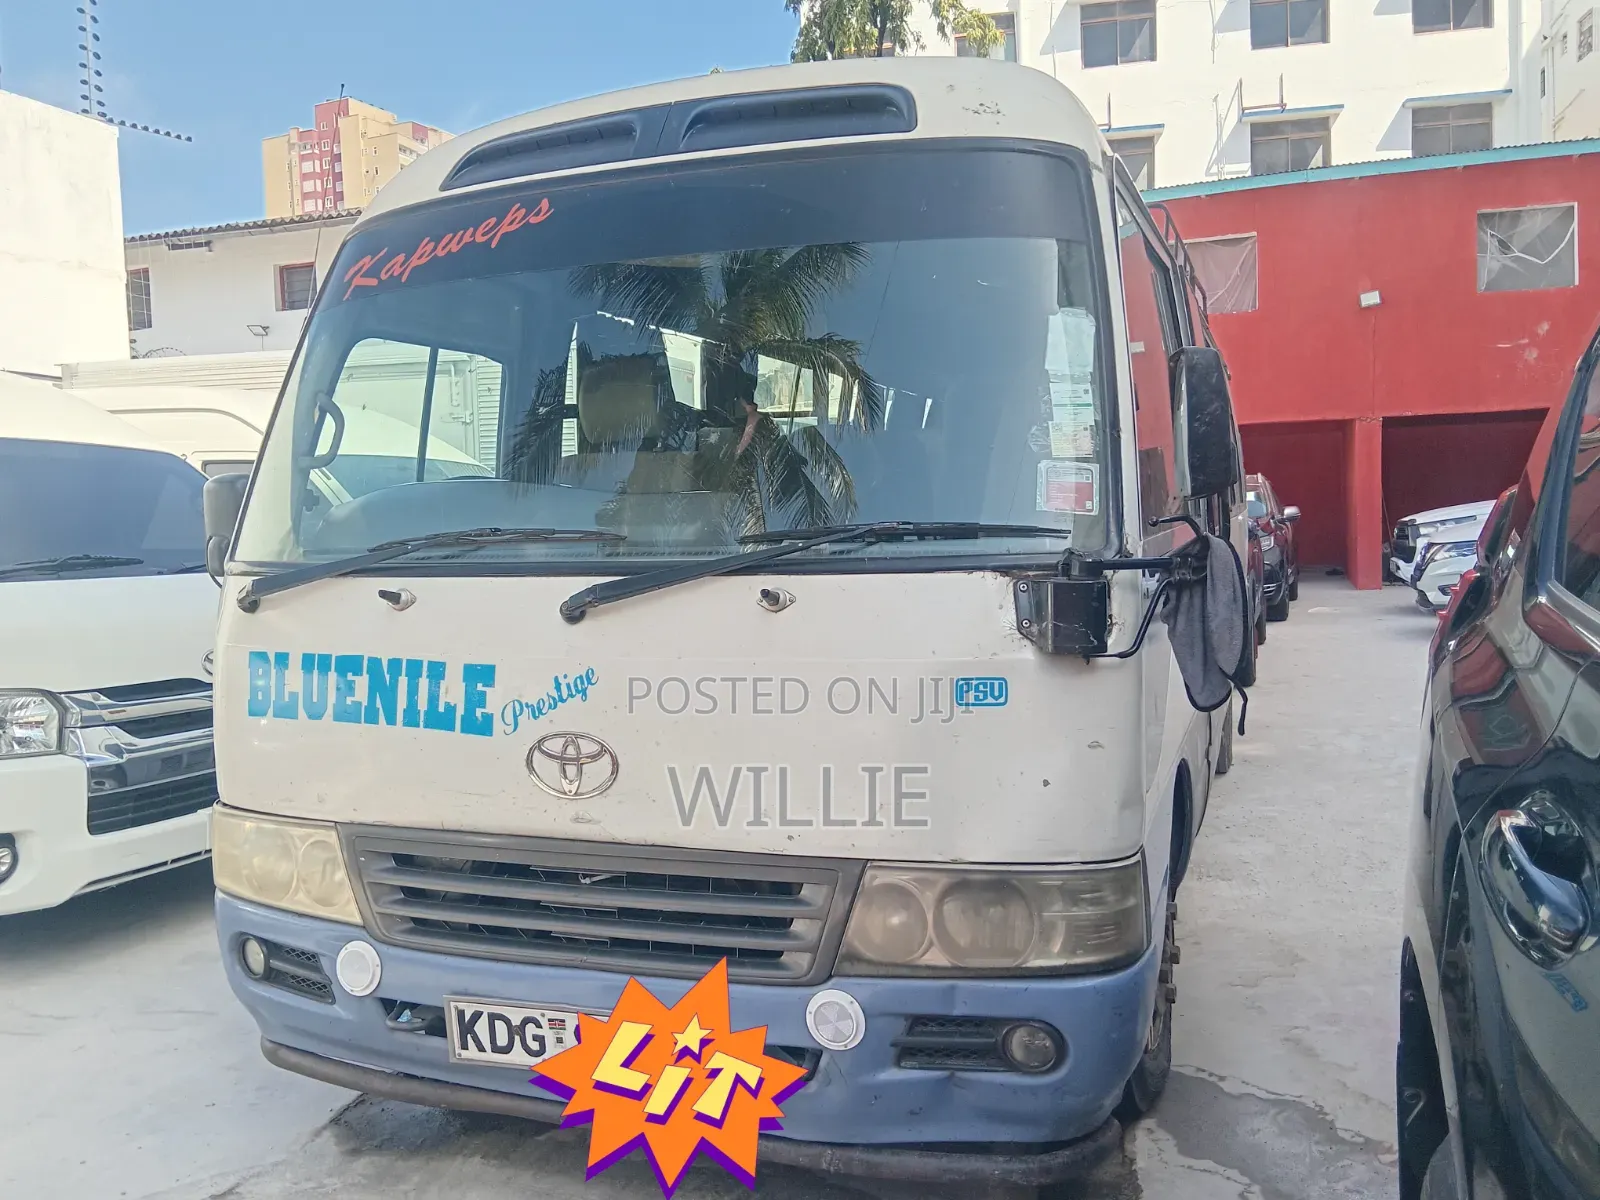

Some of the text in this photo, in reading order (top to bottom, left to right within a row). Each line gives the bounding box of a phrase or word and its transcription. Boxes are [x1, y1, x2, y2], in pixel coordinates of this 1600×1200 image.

[343, 198, 555, 301] Kapweps
[247, 650, 600, 737] BLUENILE Prestige
[957, 680, 1005, 703] PSV
[456, 1008, 548, 1059] KDG
